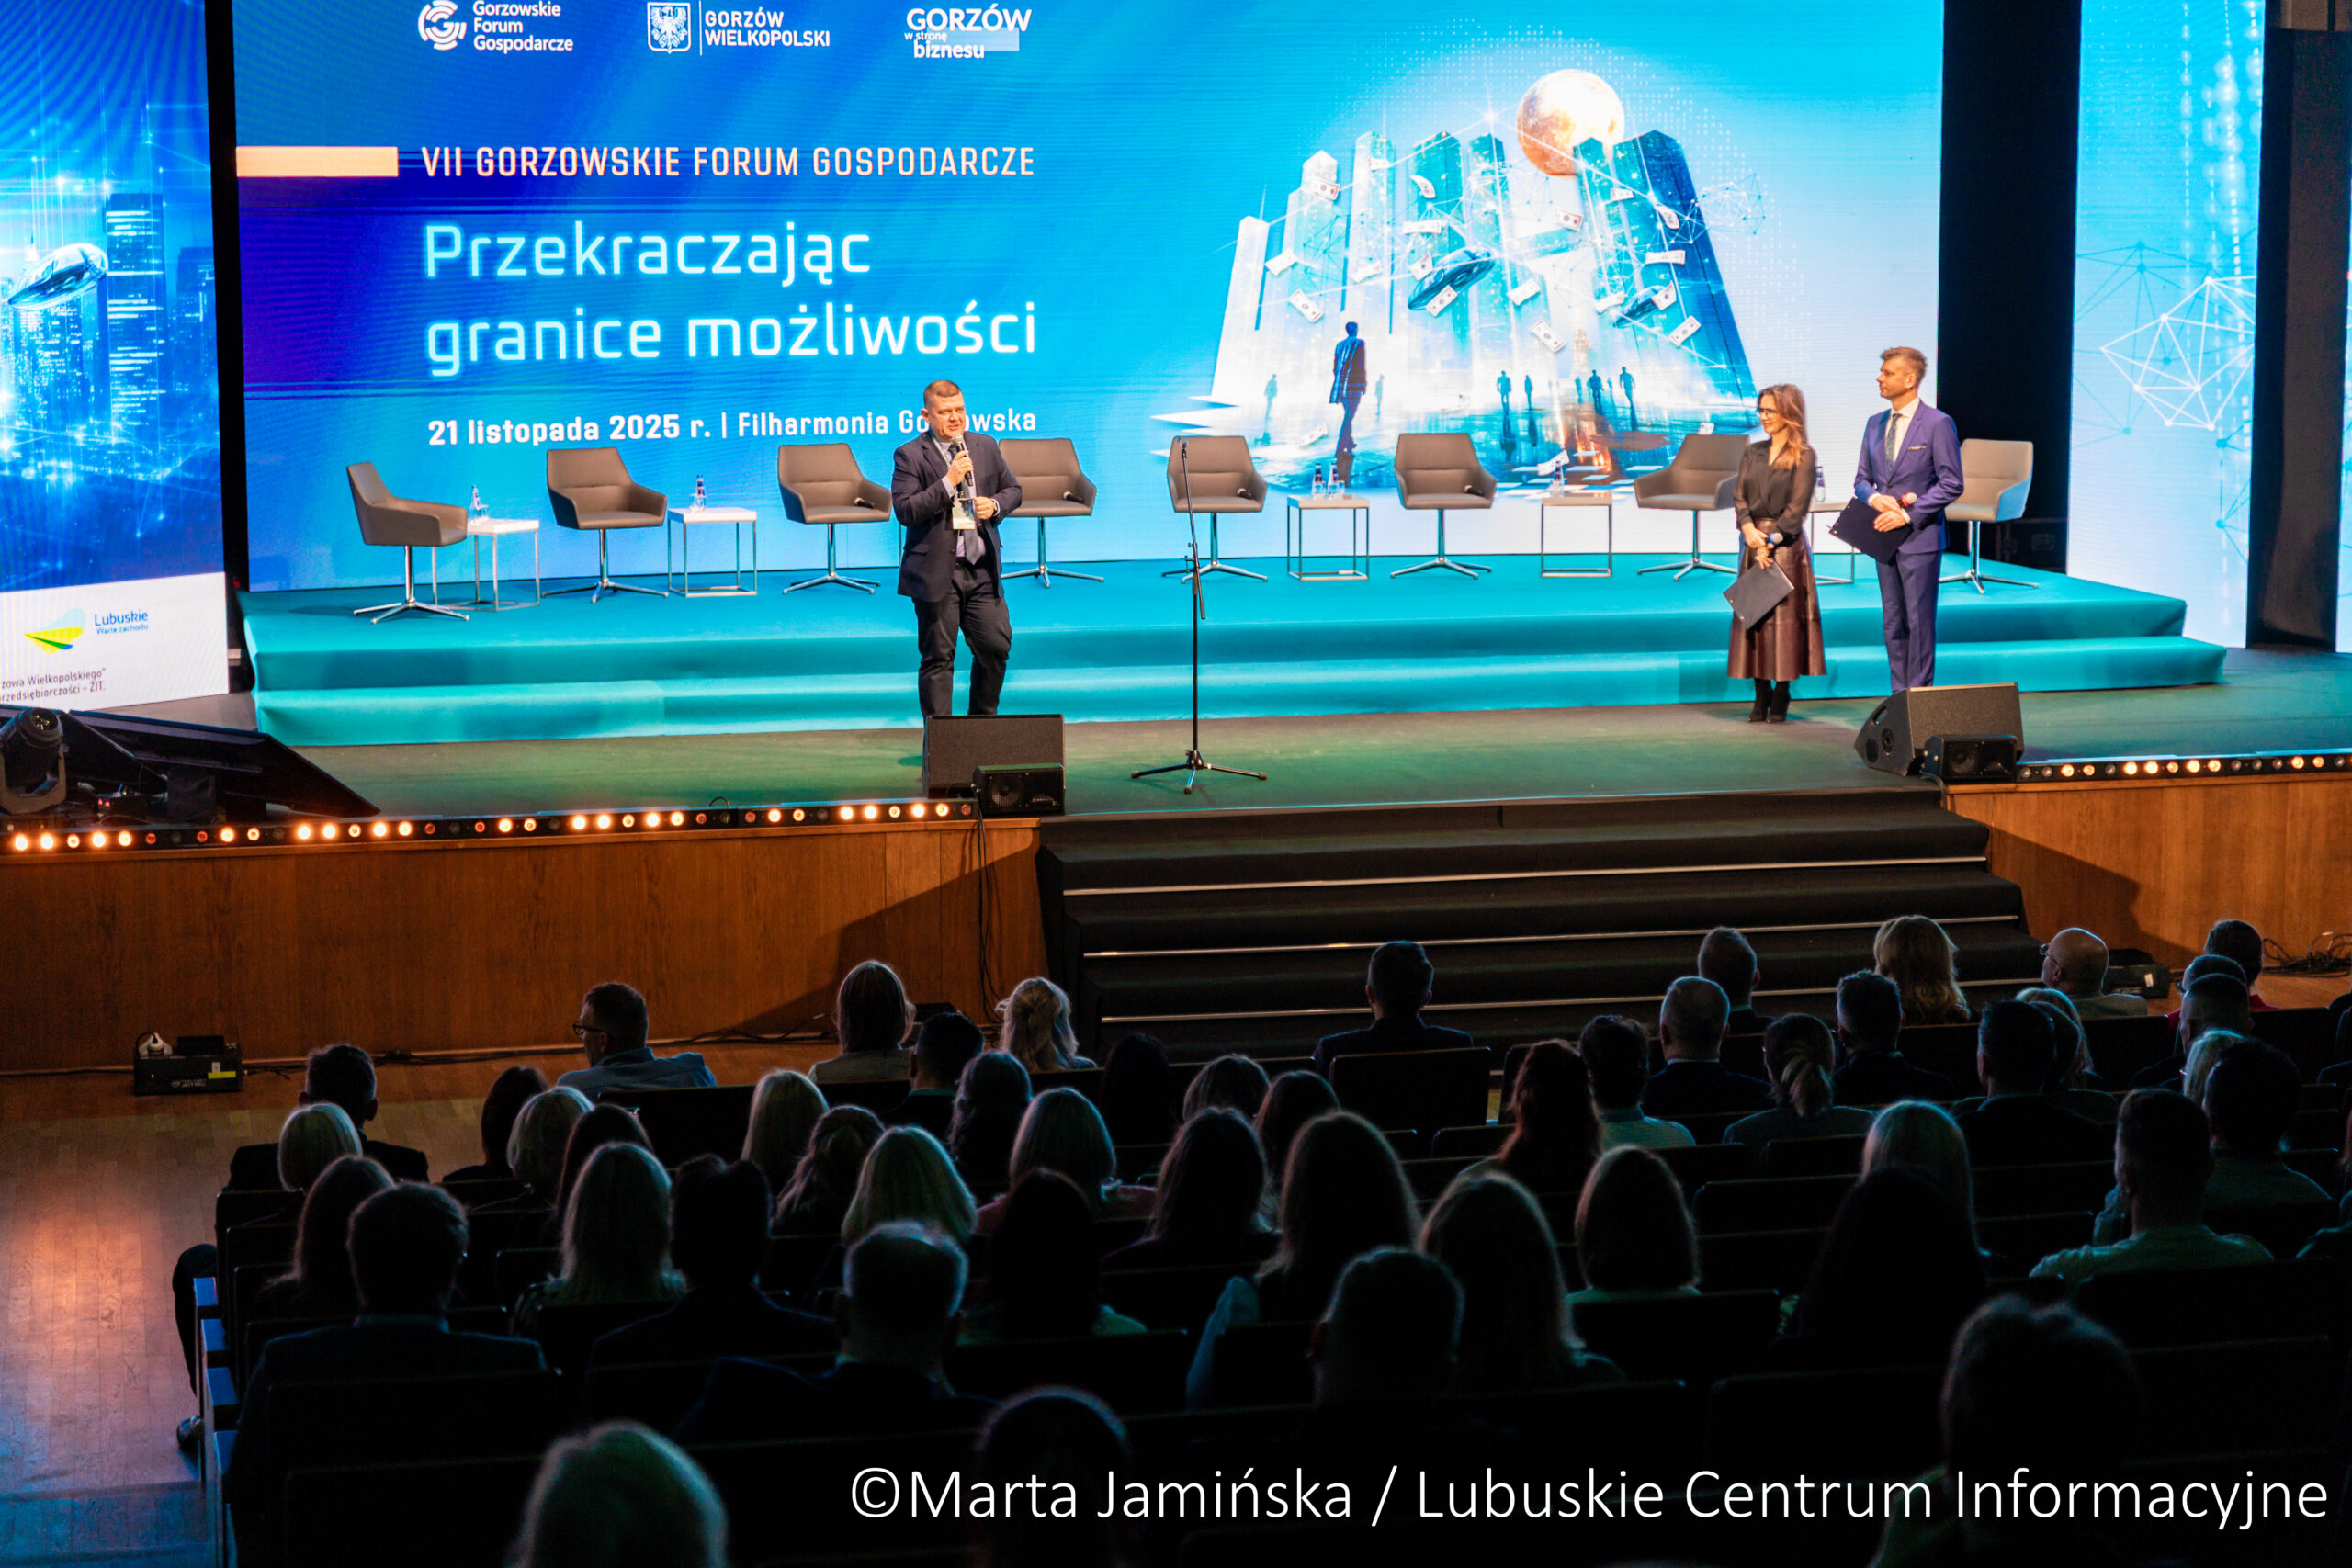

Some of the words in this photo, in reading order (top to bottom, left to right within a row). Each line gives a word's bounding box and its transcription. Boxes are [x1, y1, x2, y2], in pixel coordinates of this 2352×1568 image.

[472, 0, 561, 17] Gorzowskie
[705, 7, 785, 28] GORZÓW
[906, 3, 1033, 32] GORZÓW
[473, 17, 524, 33] Forum
[473, 35, 574, 54] Gospodarcze
[705, 29, 831, 47] WIELKOPOLSKI
[904, 32, 914, 40] w
[915, 30, 948, 42] stronę
[913, 40, 985, 59] biznesu
[422, 147, 462, 177] VII
[476, 147, 680, 177] GORZOWSKIE
[694, 147, 797, 176] FORUM
[813, 146, 1035, 175] GOSPODARCZE
[424, 220, 871, 286] Przekraczając
[427, 308, 662, 378] granice
[687, 300, 1036, 356] możliwości
[428, 420, 458, 446] 21
[468, 416, 599, 446] listopada
[609, 413, 680, 440] 2025
[690, 418, 711, 438] r.
[739, 412, 888, 436] Filharmonia
[899, 408, 1036, 434] Gowska
[95, 610, 148, 626] Lubuskie
[0, 682, 80, 702] rzedsiębiorczości
